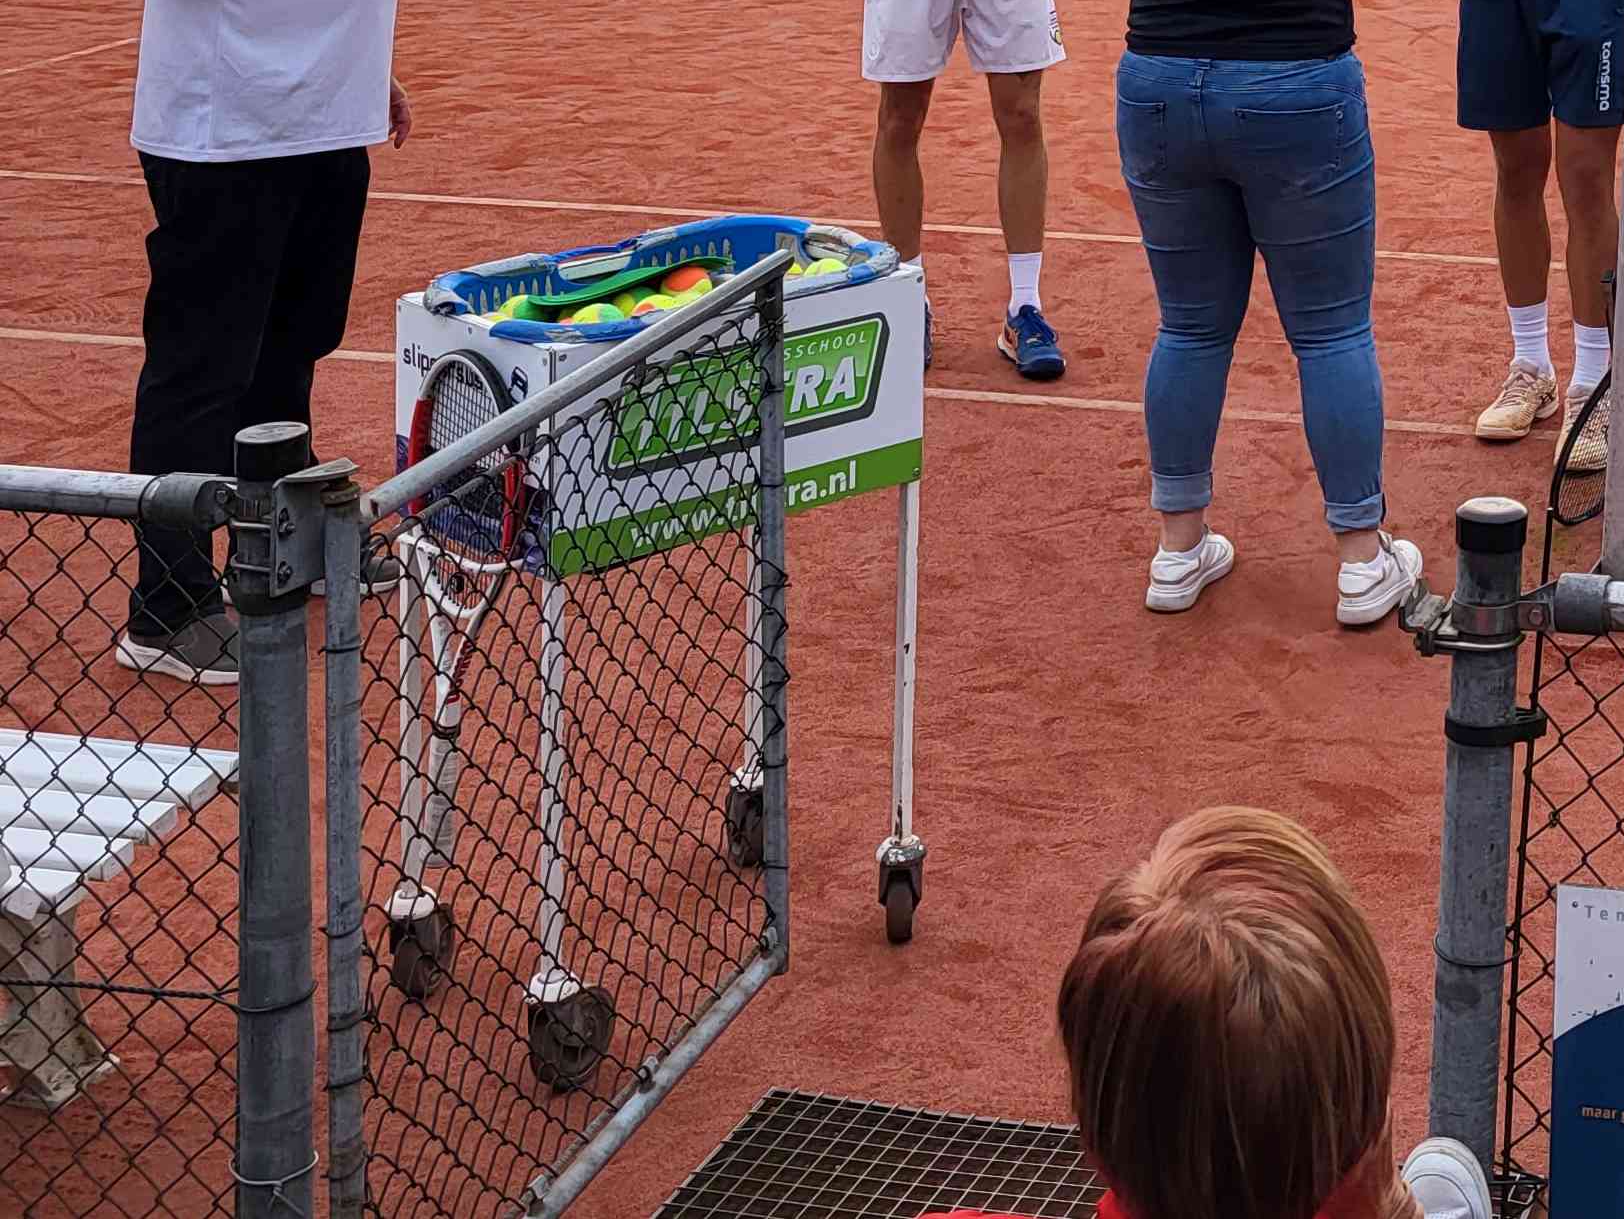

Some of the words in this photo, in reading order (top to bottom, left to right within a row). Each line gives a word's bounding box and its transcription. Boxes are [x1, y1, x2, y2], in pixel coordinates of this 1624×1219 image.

[1600, 40, 1613, 111] tamsma
[638, 355, 856, 451] TILSRA
[630, 459, 857, 548] www.tilra.nl
[1581, 1105, 1617, 1121] maar
